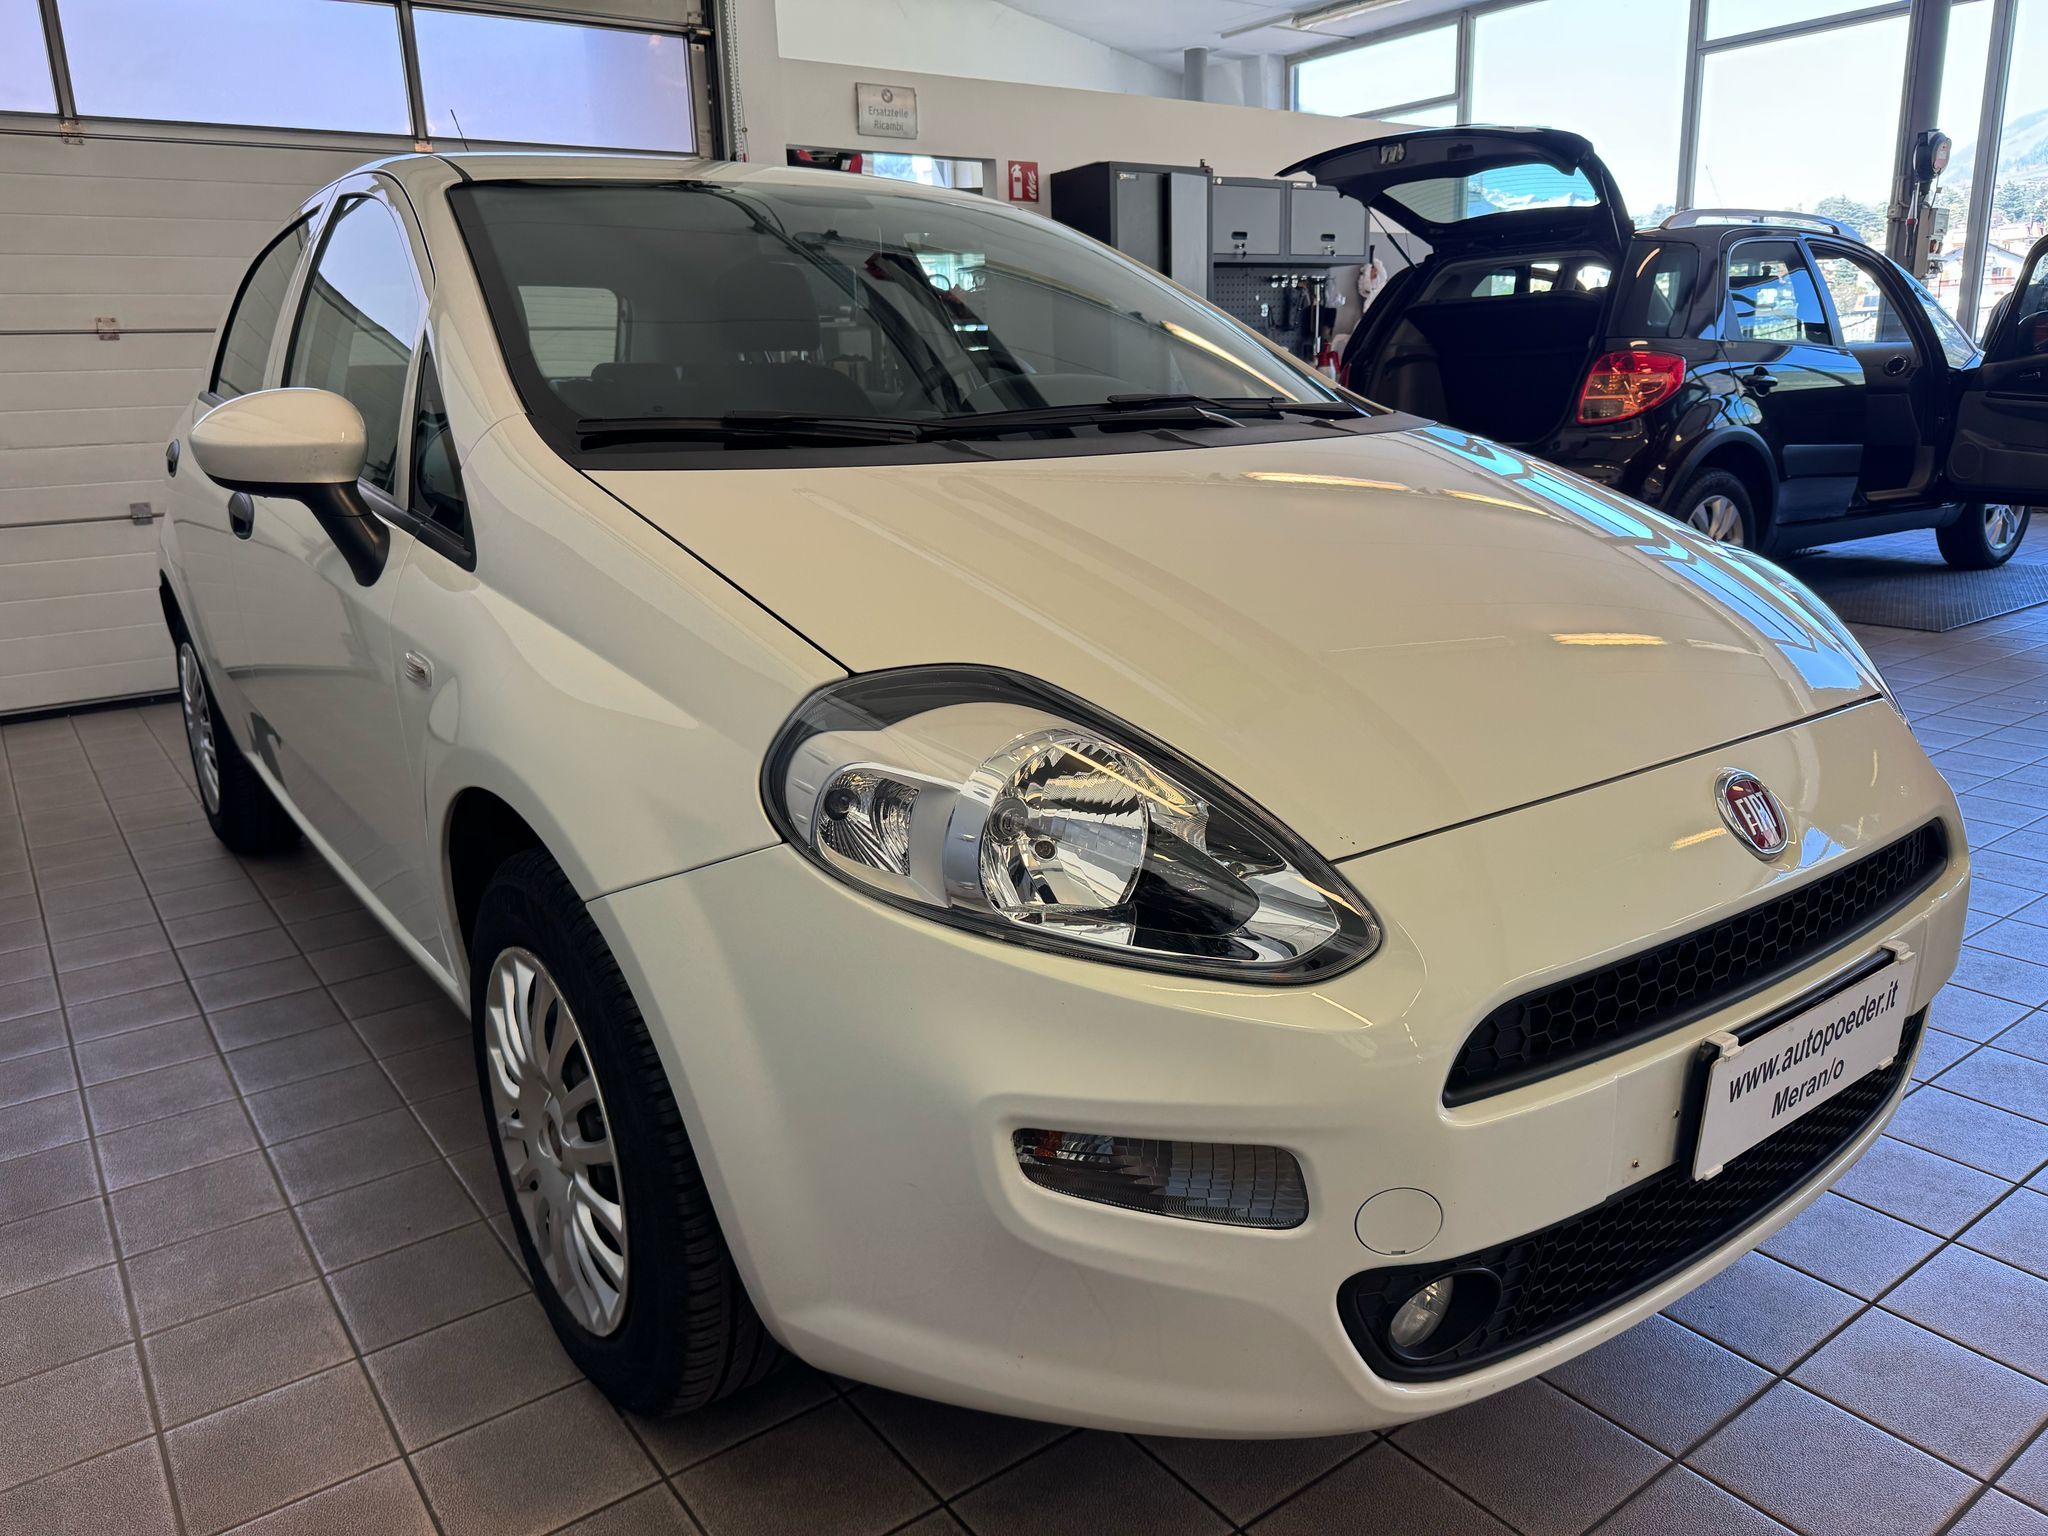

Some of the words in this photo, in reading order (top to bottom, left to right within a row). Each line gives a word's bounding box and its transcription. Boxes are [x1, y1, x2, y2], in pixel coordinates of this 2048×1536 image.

[868, 106, 909, 118] Ersatzteile
[874, 120, 904, 131] Ricambi
[1734, 791, 1777, 836] FIAT
[1729, 980, 1898, 1103] www.autopoeder.it
[1771, 1057, 1844, 1119] Meran/o
